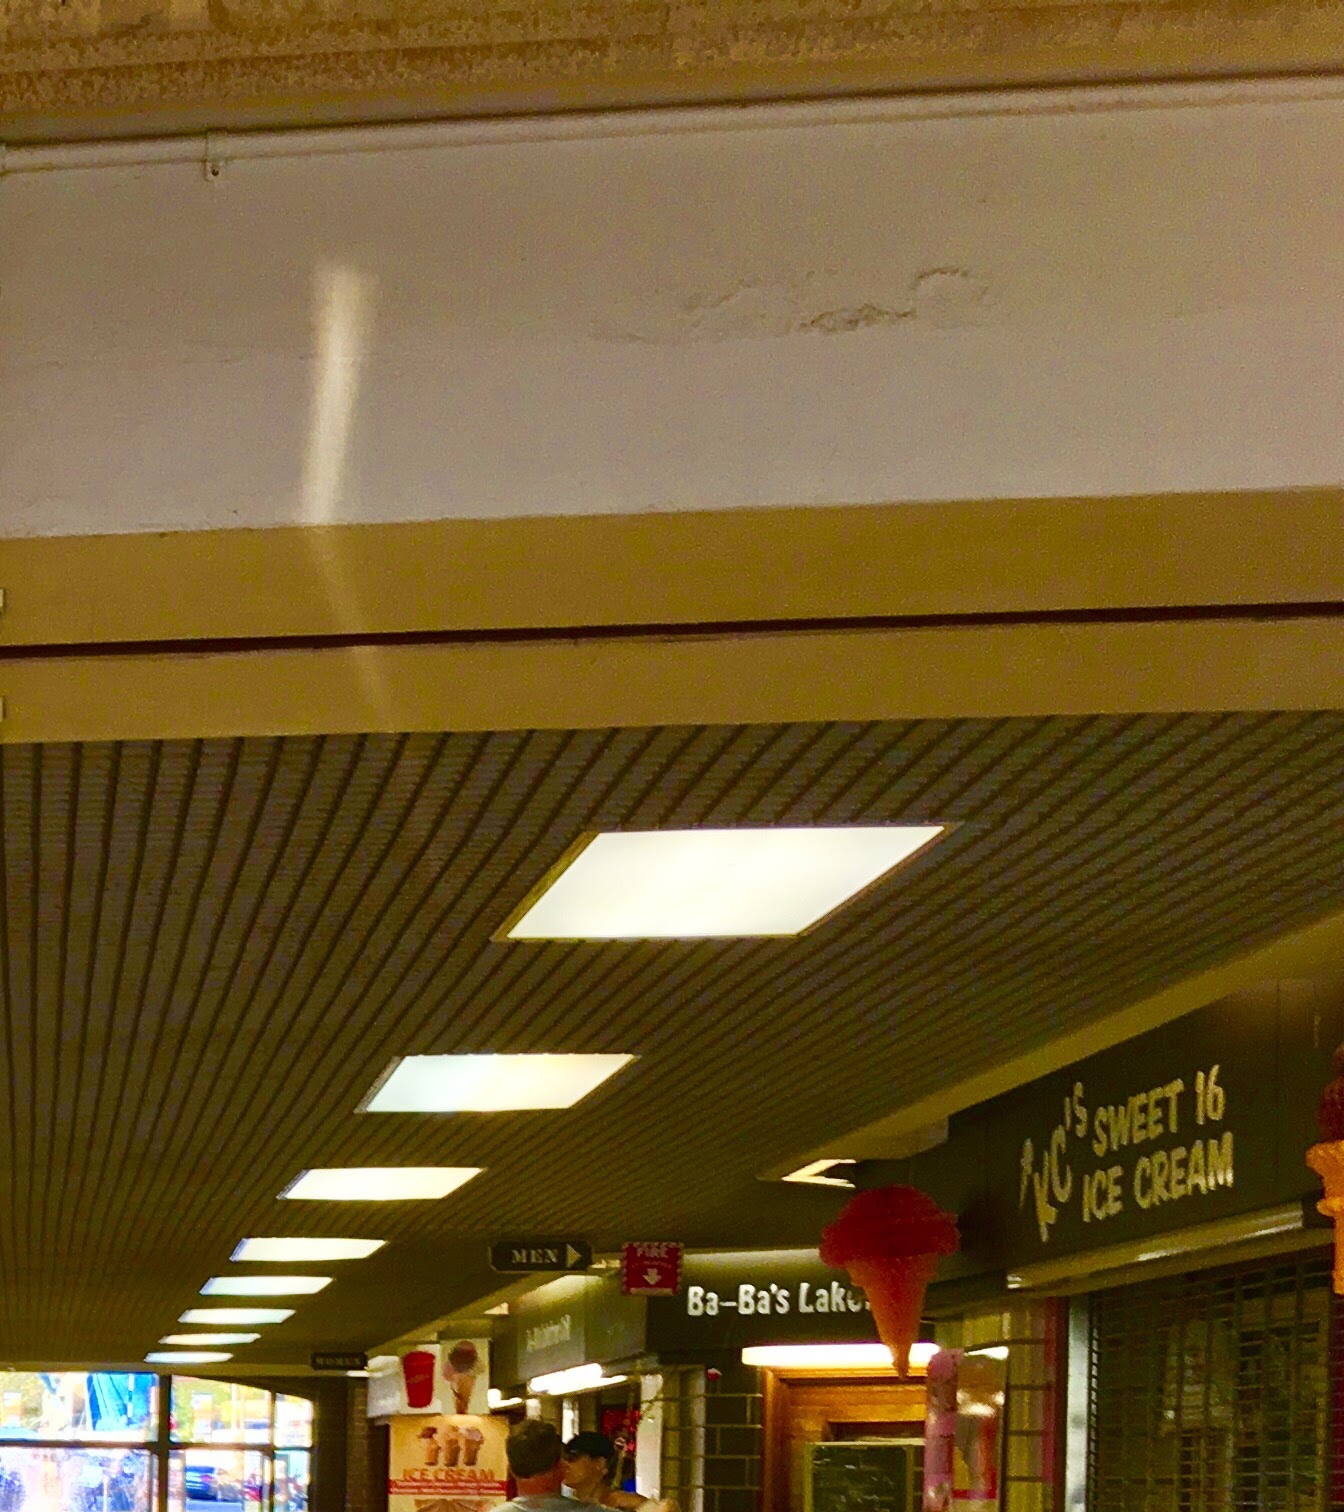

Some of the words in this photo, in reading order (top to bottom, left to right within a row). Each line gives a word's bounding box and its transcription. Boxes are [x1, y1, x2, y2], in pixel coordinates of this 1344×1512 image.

[1092, 1078, 1185, 1158] SWEET
[1195, 1064, 1226, 1126] 16
[1083, 1165, 1124, 1223] ICE
[1134, 1131, 1234, 1209] CREAM
[512, 1247, 558, 1264] MEN
[687, 1283, 790, 1316] Ba-Ba's
